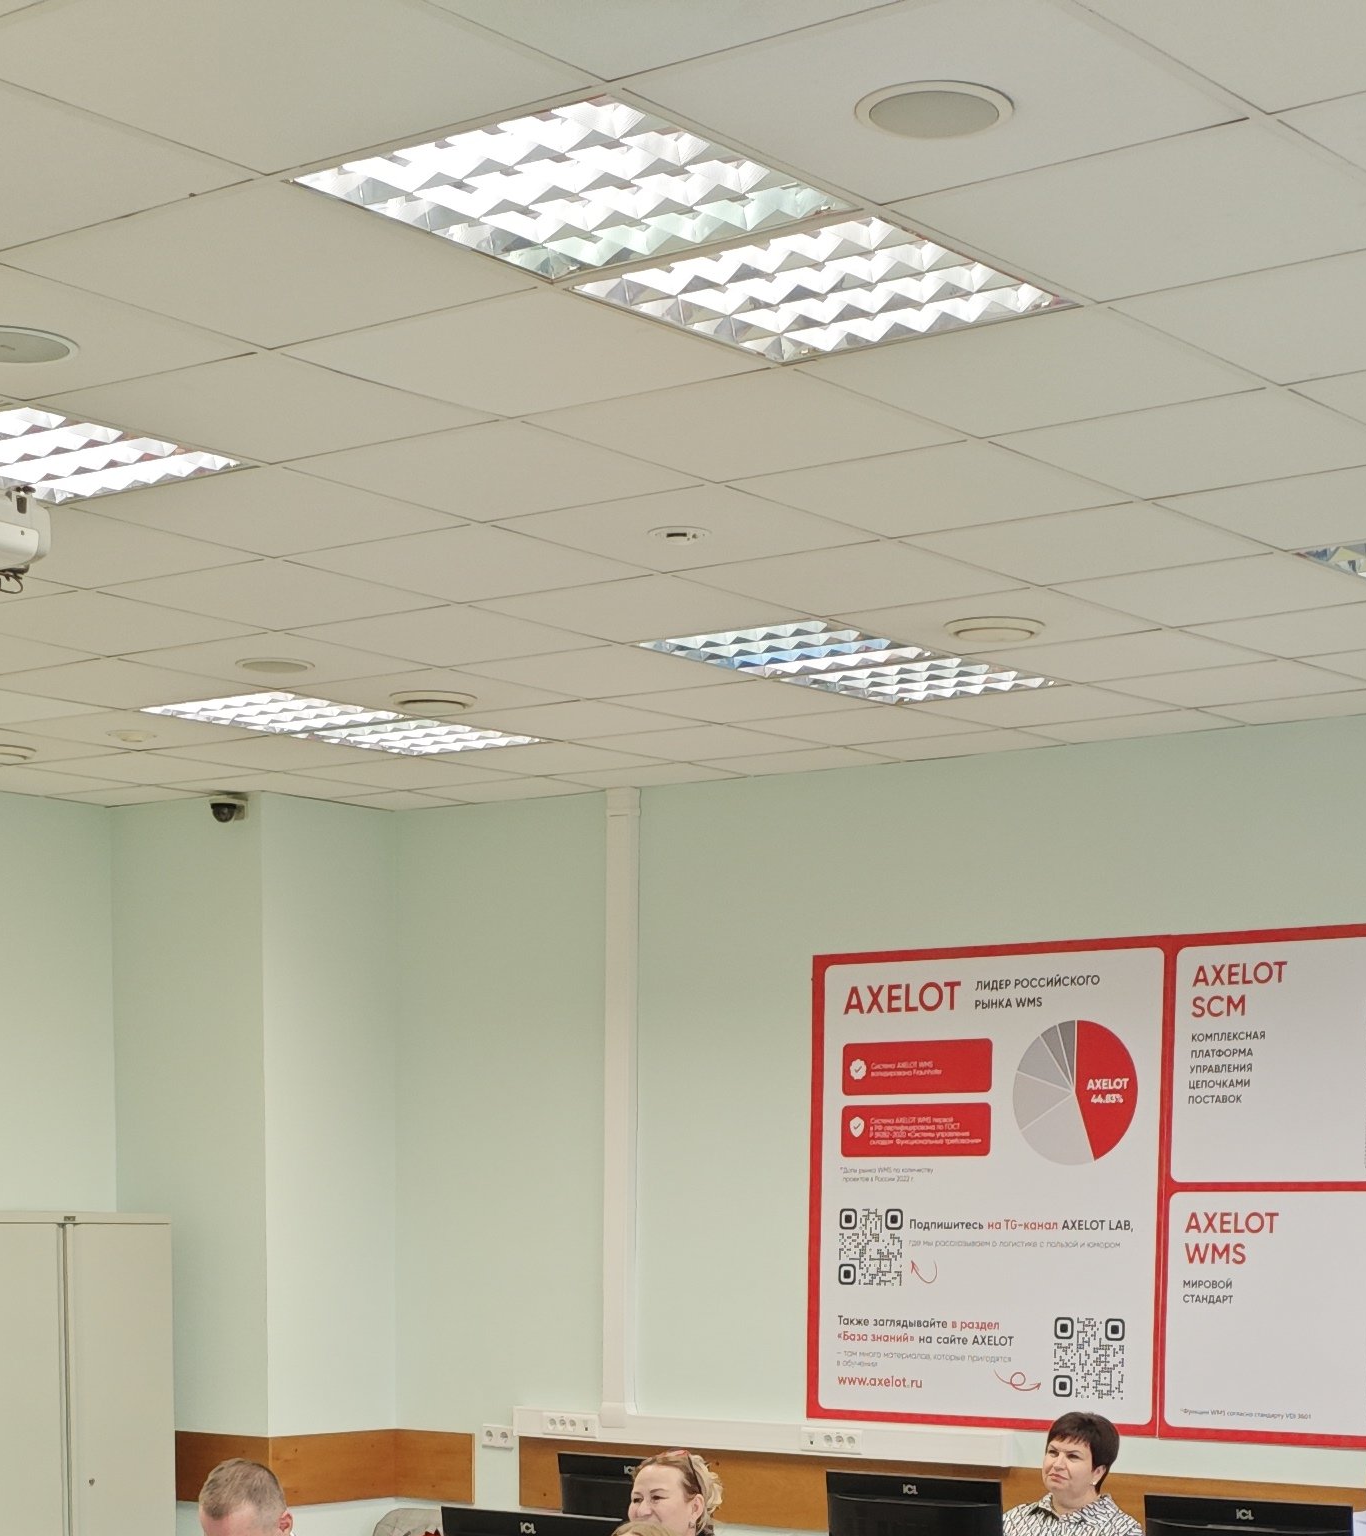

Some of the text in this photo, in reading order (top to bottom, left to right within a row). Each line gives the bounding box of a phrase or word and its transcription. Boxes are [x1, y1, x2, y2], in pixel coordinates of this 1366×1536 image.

[1192, 960, 1287, 987] AXELOT
[975, 972, 1100, 992] ЛИДЕР РОССИЙСКОГО
[843, 980, 961, 1015] AXELOT
[974, 996, 1042, 1009] РЫНКА WMS
[1191, 994, 1245, 1018] SCM
[1191, 1030, 1265, 1042] КОМПЛЕКСНАЯ
[1190, 1047, 1253, 1058] ПЛАТФОРМА
[1189, 1062, 1252, 1074] УПРАВЛЕНИЯ
[1086, 1077, 1129, 1090] AXELOT
[1188, 1078, 1250, 1090] ЦЕПОЧКАМИ
[1187, 1094, 1242, 1104] ПОСТАВОК
[909, 1218, 1133, 1232] Подпишитесь на TG-канал AXELOT LAB,
[1184, 1211, 1279, 1233] AXELOT
[1184, 1242, 1246, 1265] WMS
[1182, 1277, 1232, 1289] МИРОВОЙ
[1182, 1293, 1233, 1305] СТАНДАРТ
[837, 1314, 999, 1332] Также заглядывайте в раздел
[837, 1330, 1014, 1346] «База знаний» на сайте AXELOT
[837, 1373, 922, 1388] www.axelot.ru
